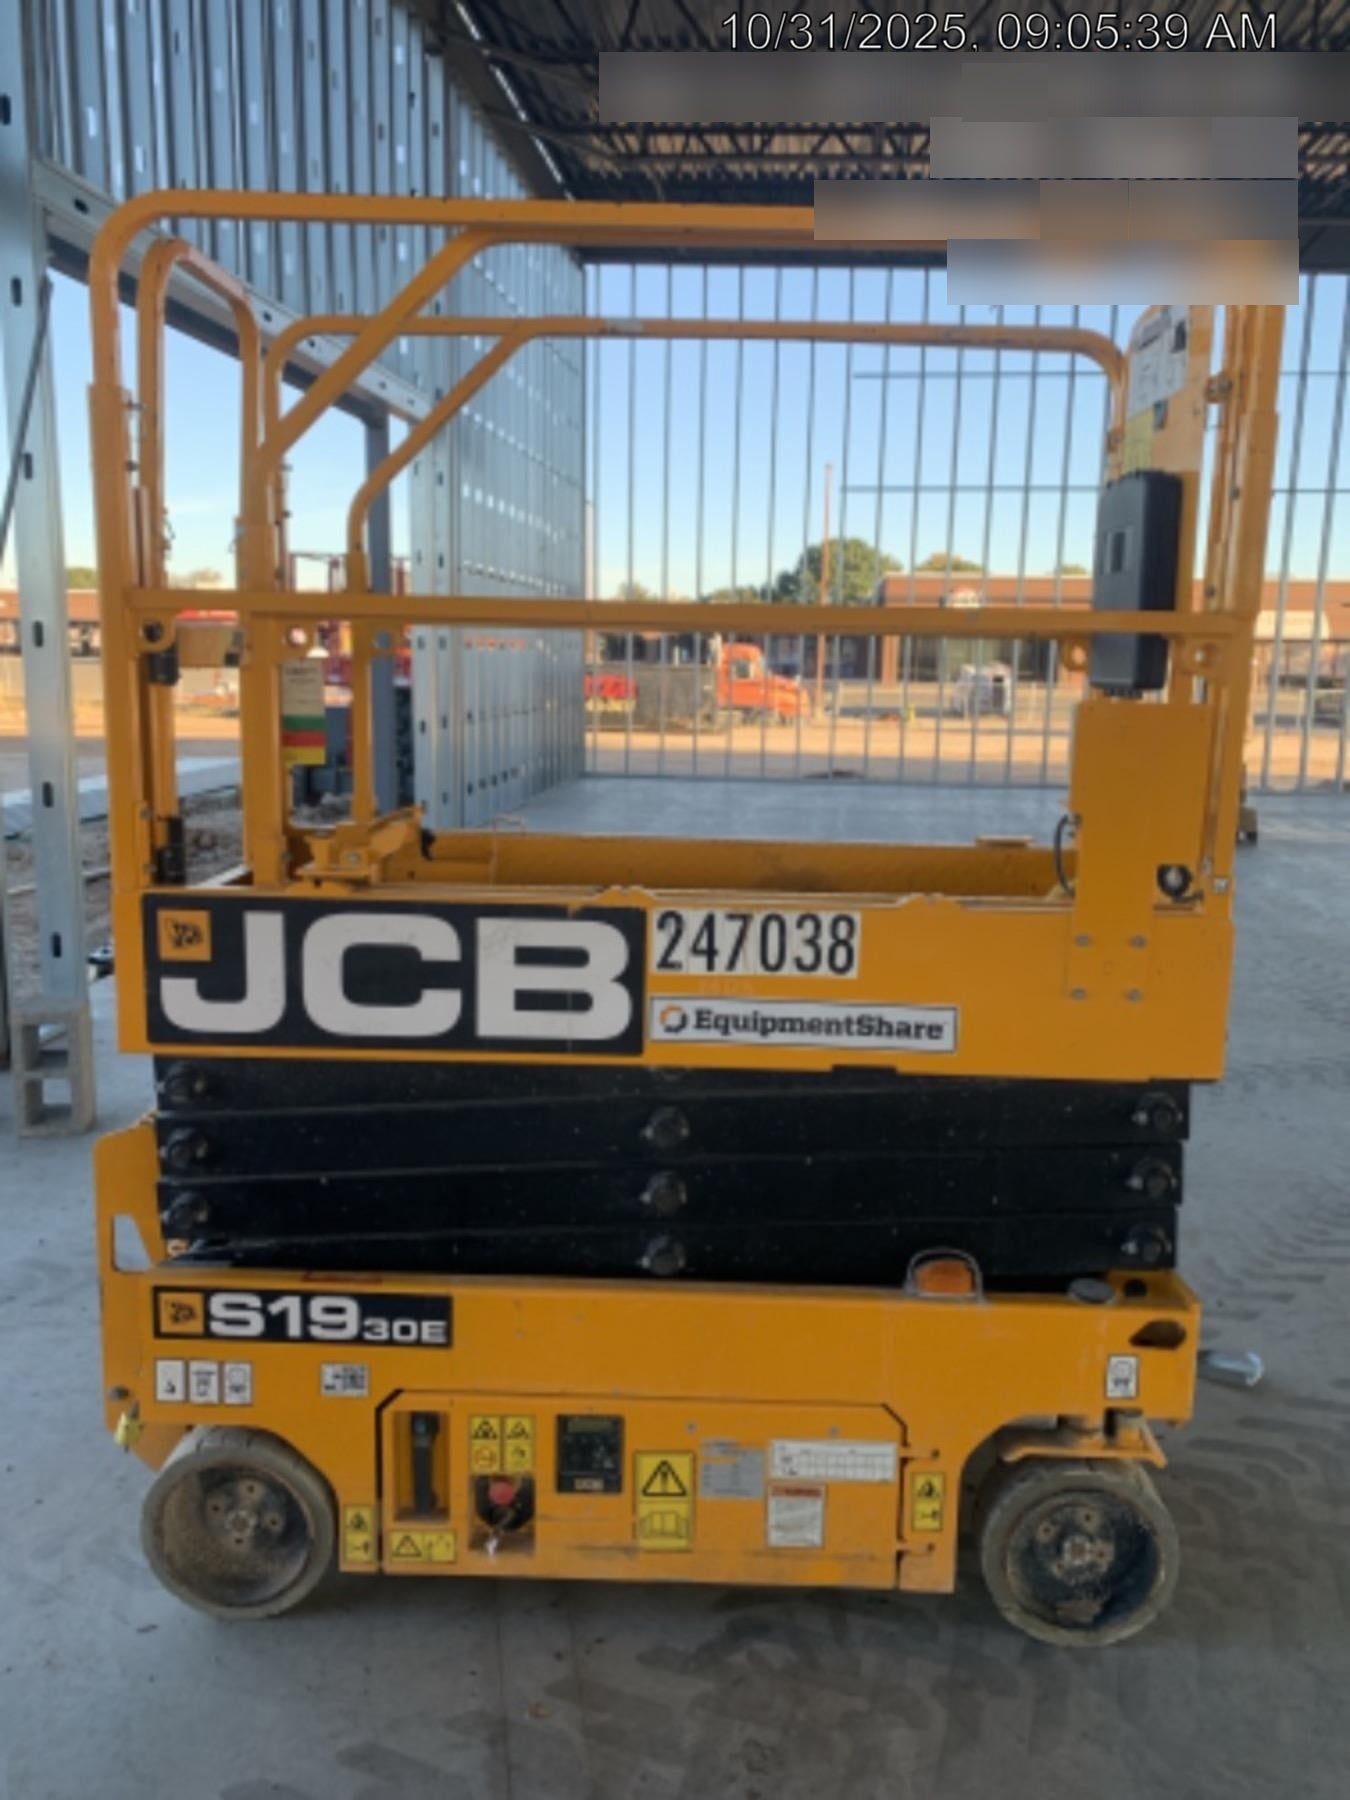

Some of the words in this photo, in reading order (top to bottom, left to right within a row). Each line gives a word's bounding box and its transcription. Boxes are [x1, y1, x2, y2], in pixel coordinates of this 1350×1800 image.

[656, 910, 856, 975] 247038
[160, 911, 632, 1040] JCB
[694, 1009, 944, 1041] EquipmentShare
